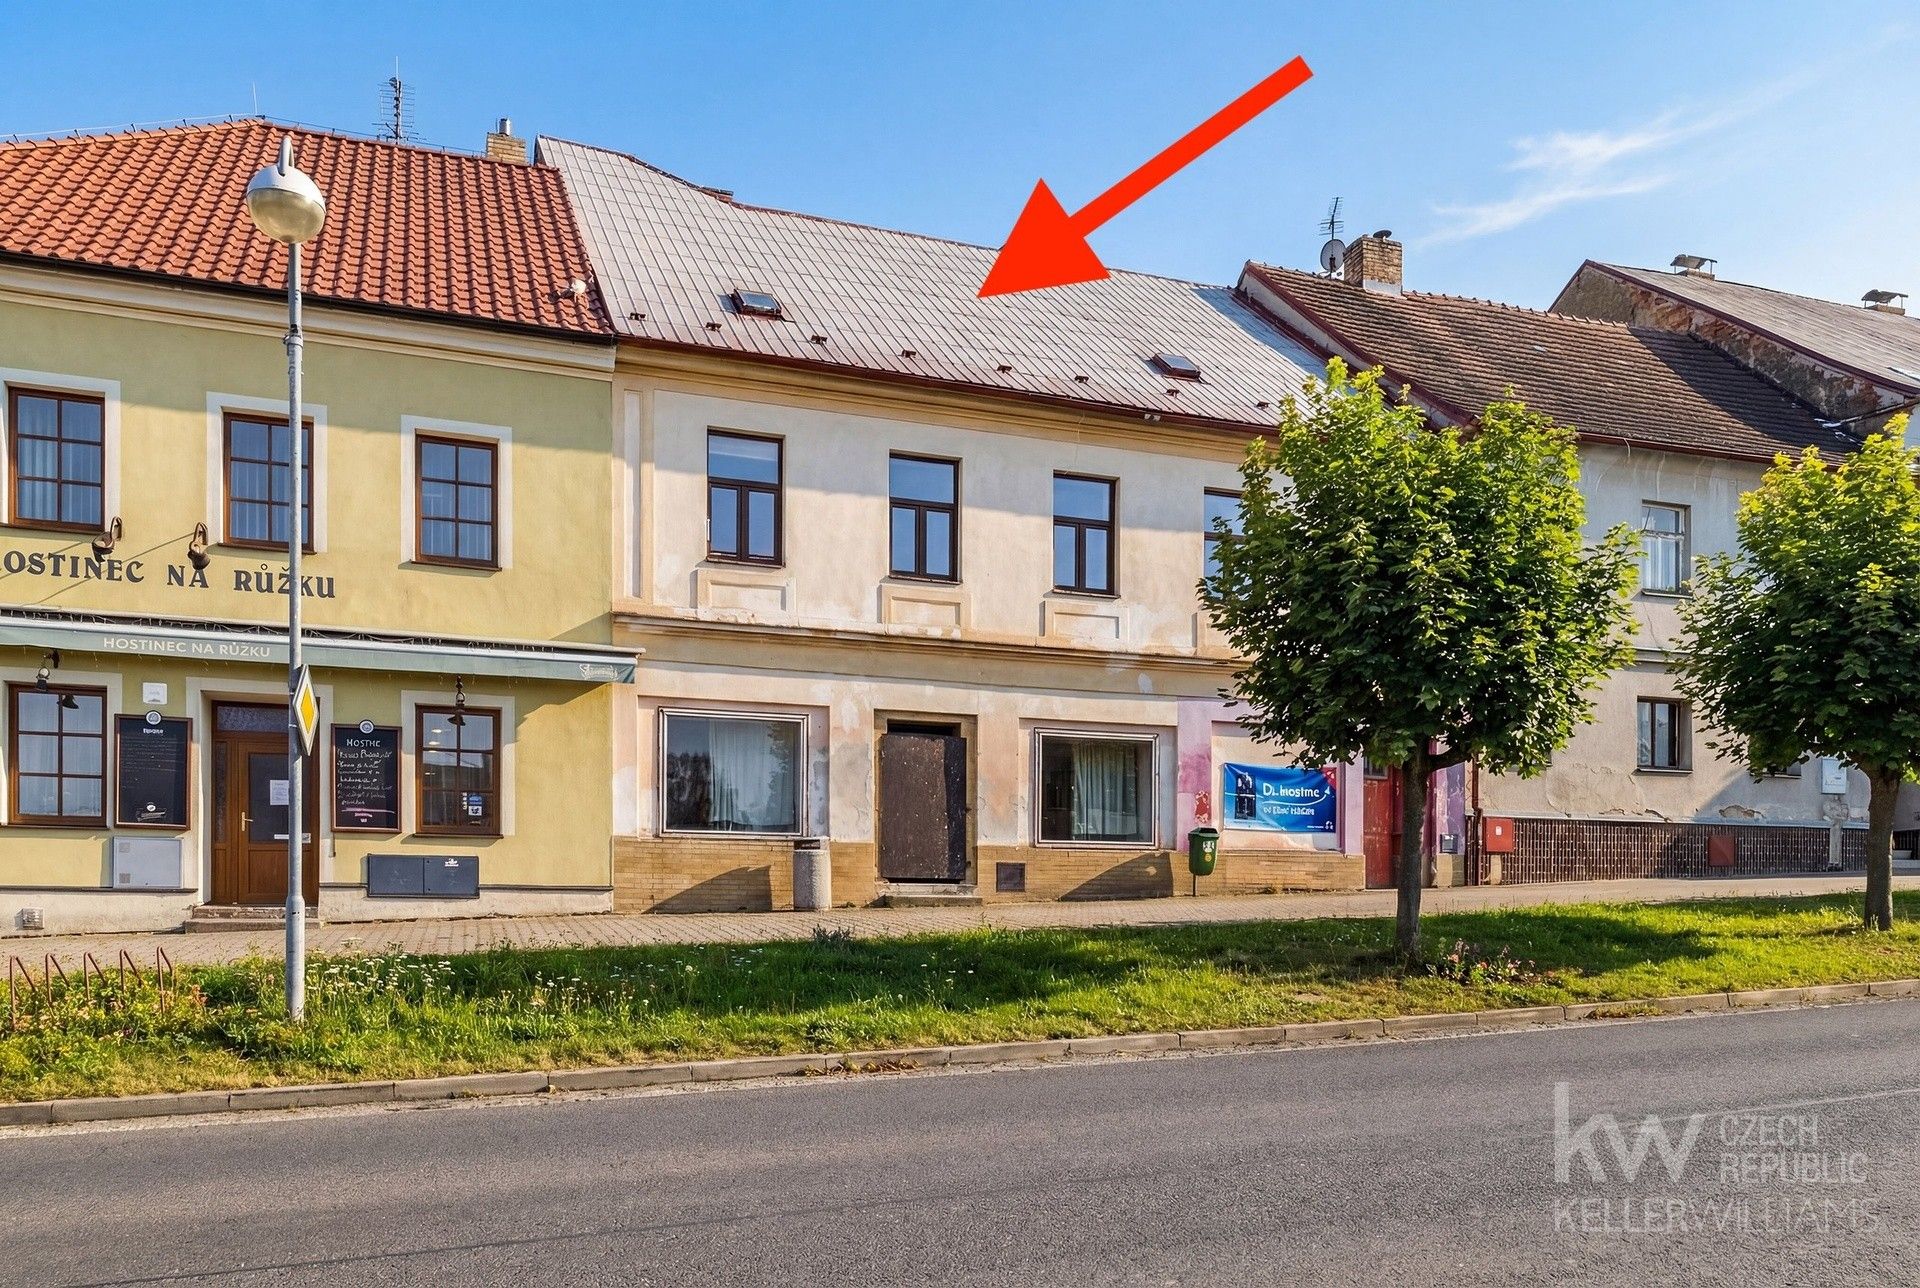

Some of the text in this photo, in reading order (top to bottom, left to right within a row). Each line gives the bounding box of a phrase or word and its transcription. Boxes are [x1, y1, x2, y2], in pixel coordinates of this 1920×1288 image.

[0, 550, 336, 598] OSTINEC NA RŮŽKU
[103, 637, 271, 657] HOSTINEC NA RŮŽKU
